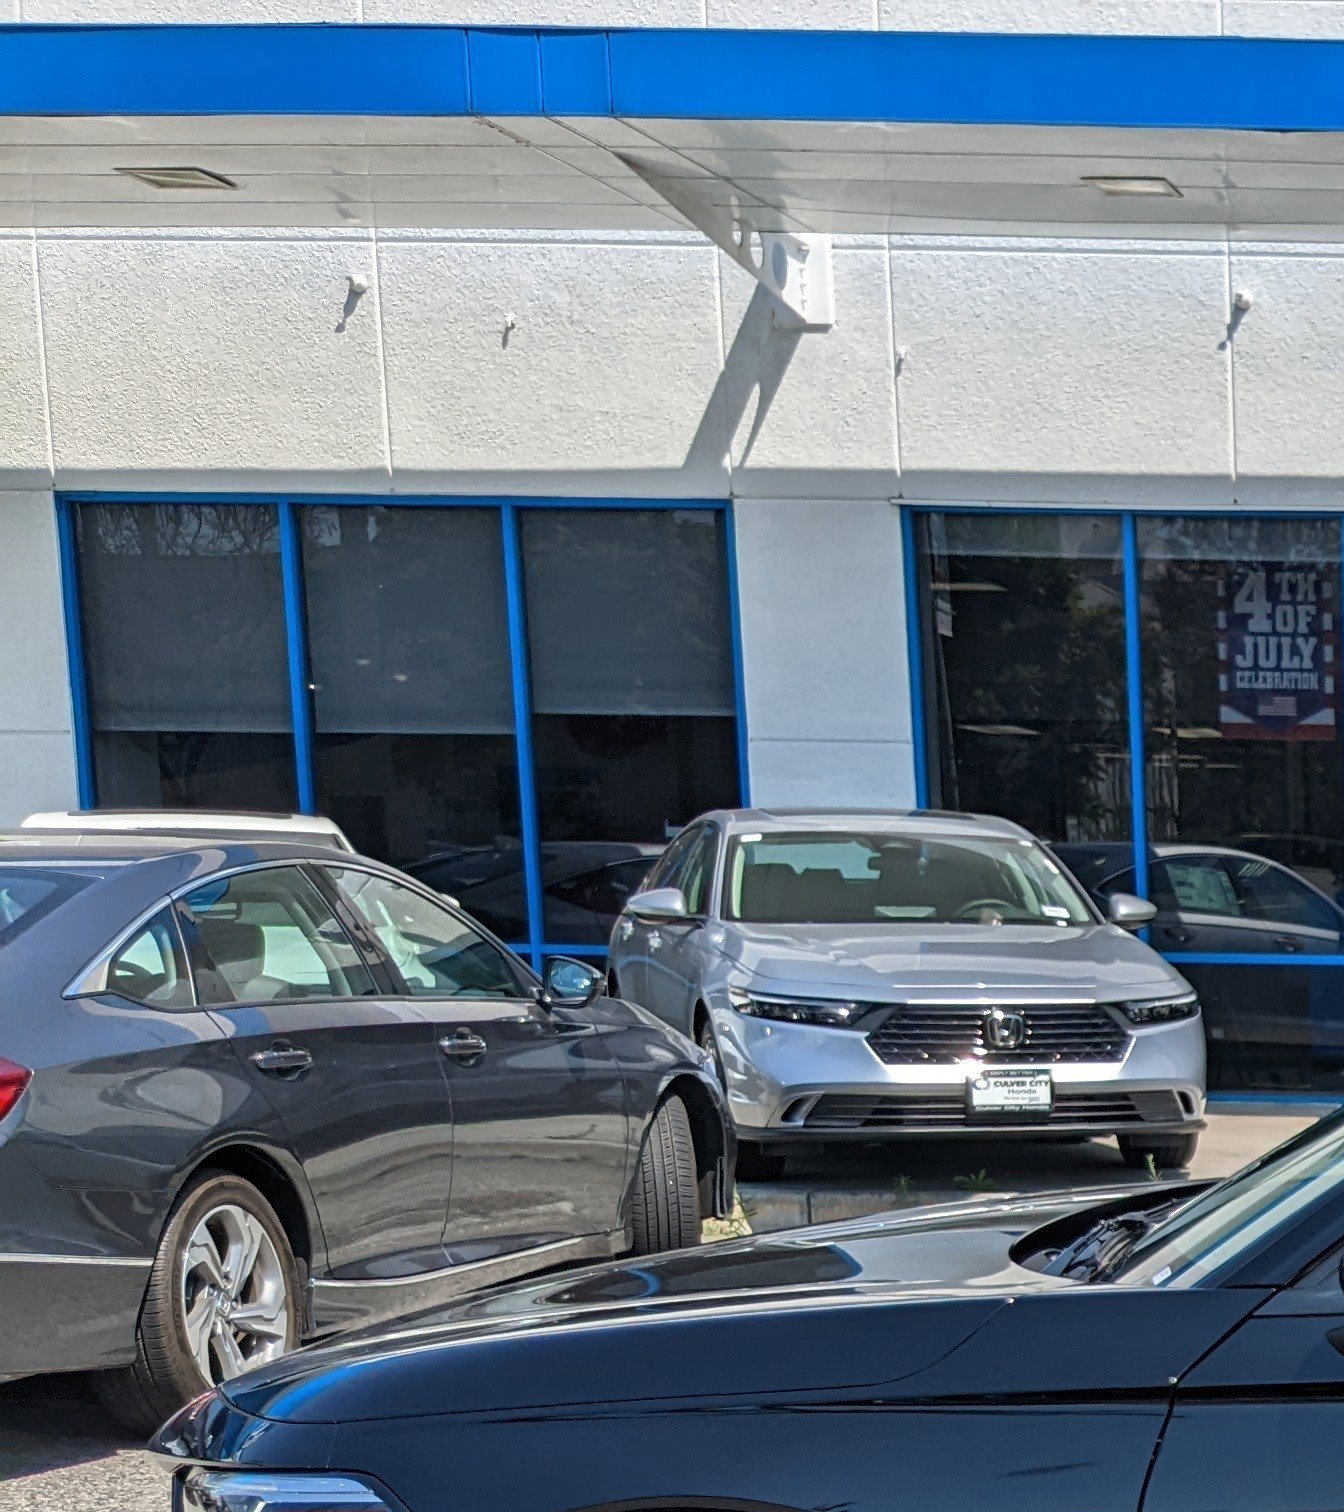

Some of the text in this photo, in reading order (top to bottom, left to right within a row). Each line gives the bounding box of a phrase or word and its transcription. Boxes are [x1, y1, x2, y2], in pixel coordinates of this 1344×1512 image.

[1275, 604, 1317, 634] OF
[1236, 636, 1318, 669] JULY
[1236, 671, 1318, 690] CELEBRATION
[994, 1080, 1050, 1088] CULVER CITY
